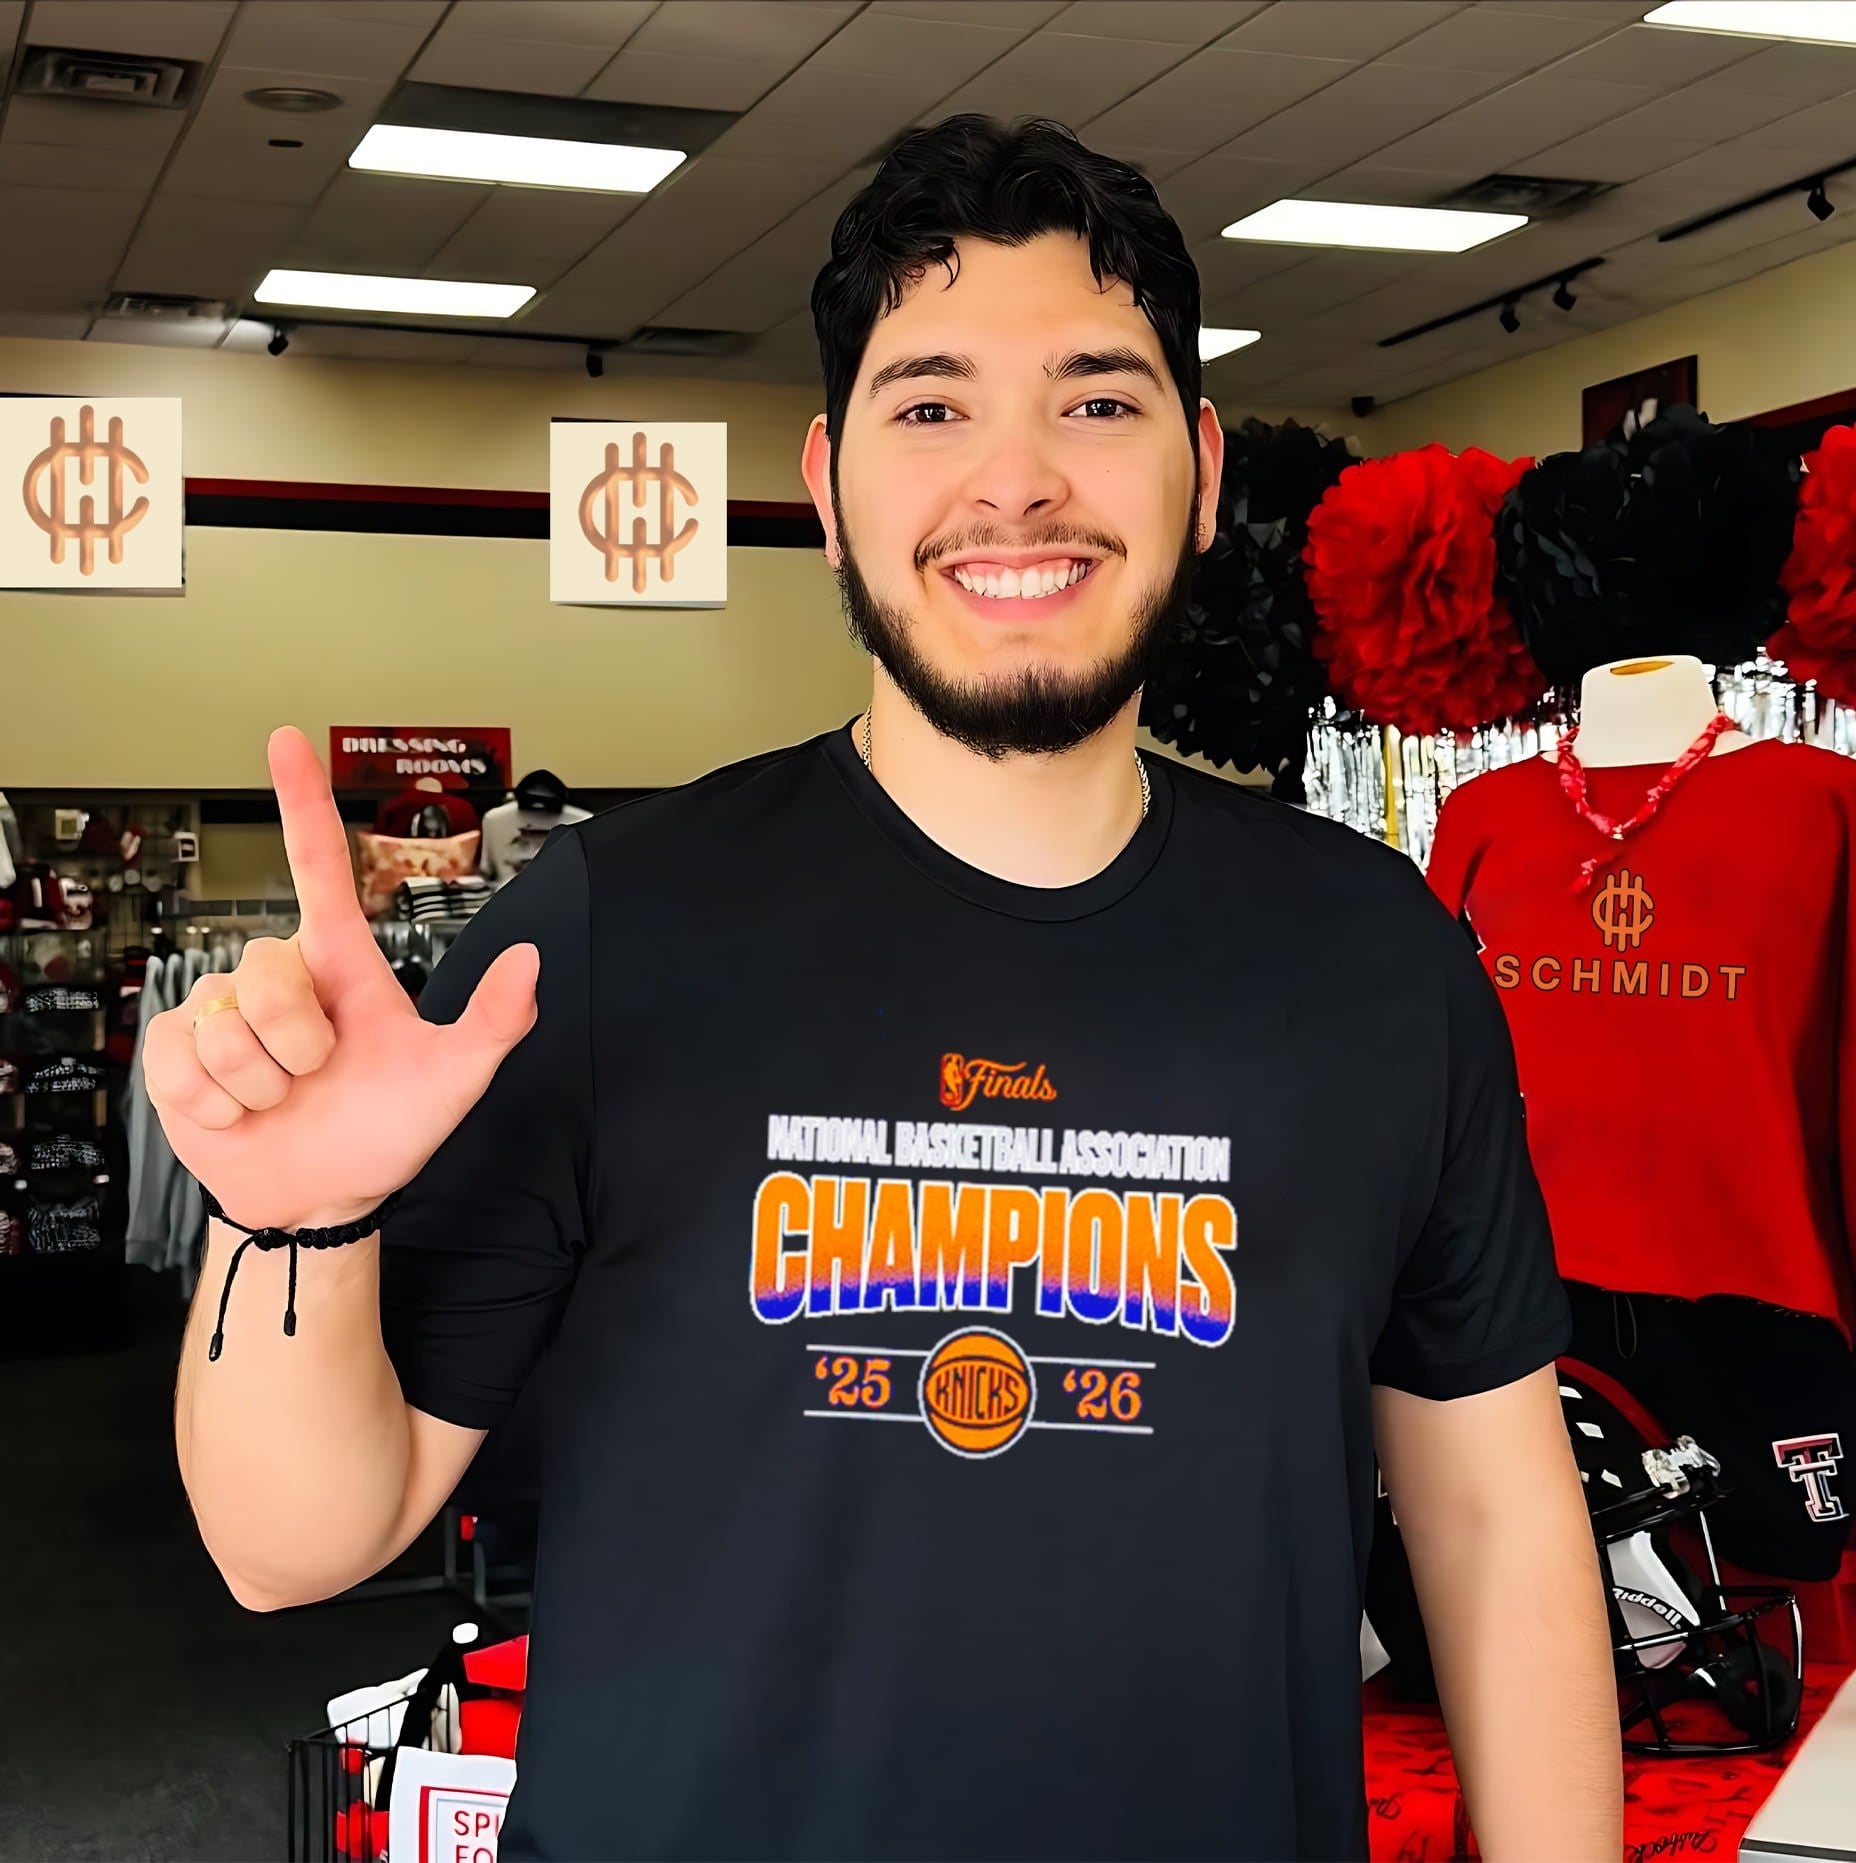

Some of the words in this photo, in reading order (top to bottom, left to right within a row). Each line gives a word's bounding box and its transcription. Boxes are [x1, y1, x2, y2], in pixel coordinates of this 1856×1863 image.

[342, 737, 467, 754] DRESSING
[396, 758, 487, 775] ROOMS
[1494, 953, 1747, 1001] SCHMIDT
[950, 1058, 1058, 1111] Finals
[767, 1114, 892, 1166] NATIONAL
[894, 1121, 1058, 1175] BASKETBALL
[1059, 1129, 1231, 1182] ASSOCIATION
[749, 1171, 1238, 1348] CHAMPIONS
[935, 1364, 1020, 1420] KNICKS
